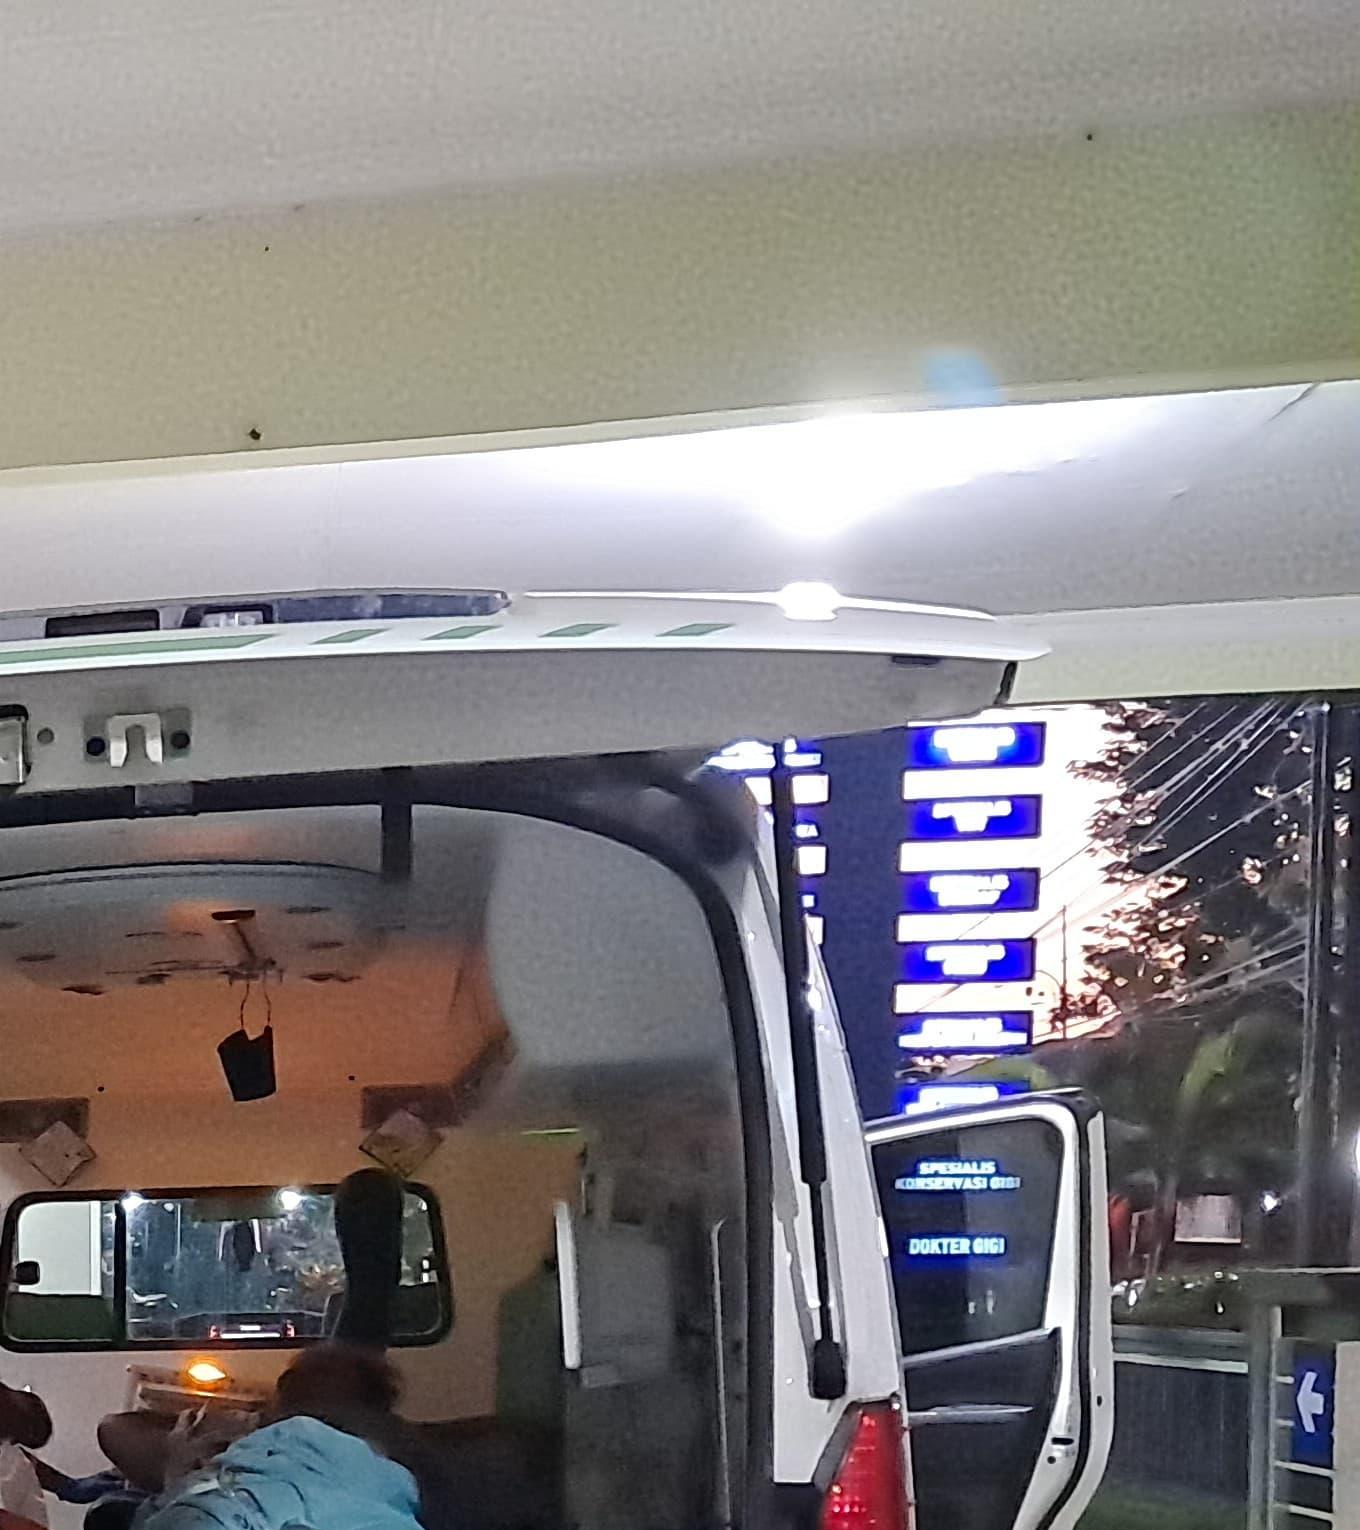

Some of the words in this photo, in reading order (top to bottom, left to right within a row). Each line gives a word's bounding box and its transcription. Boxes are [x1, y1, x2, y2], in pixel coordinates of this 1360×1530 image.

[918, 1161, 997, 1175] SPESIALIS
[908, 1238, 971, 1256] DOKTER
[972, 1237, 1006, 1255] GIGI
